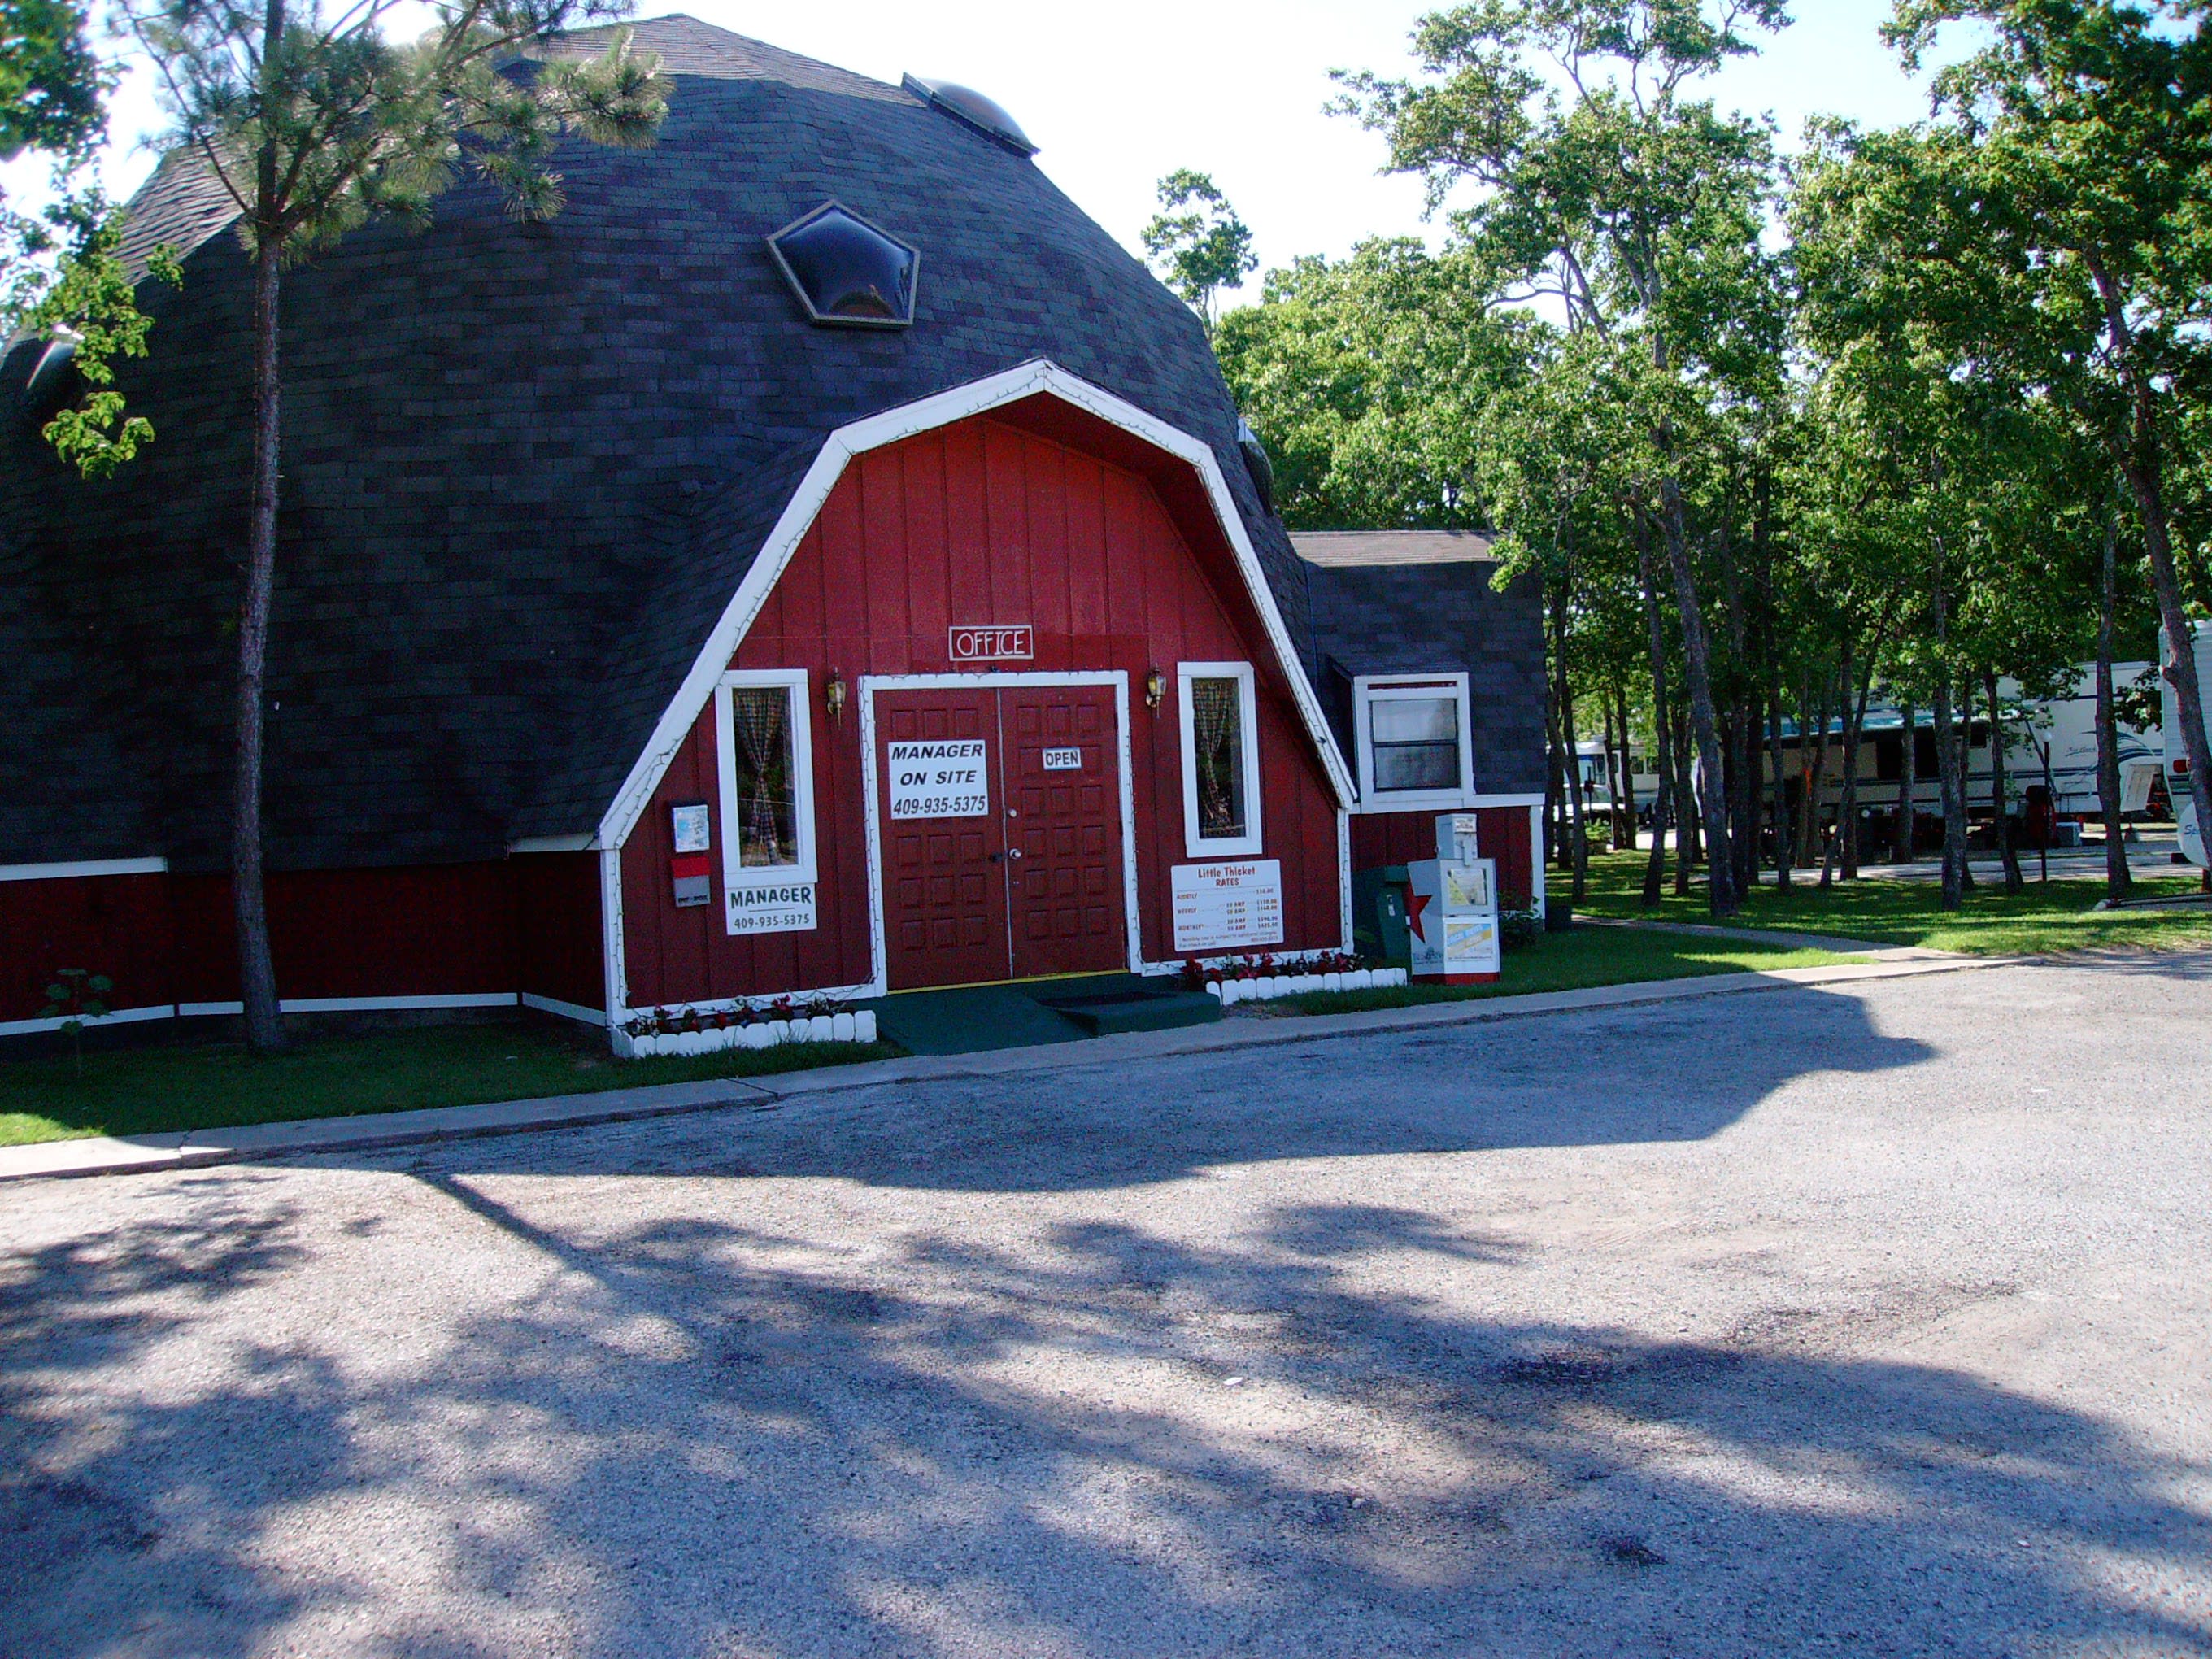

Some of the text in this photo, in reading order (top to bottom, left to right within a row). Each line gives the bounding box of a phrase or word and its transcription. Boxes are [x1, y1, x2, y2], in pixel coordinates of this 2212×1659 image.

[956, 630, 1026, 656] OFFICE
[891, 744, 983, 760] MANAGER
[1045, 751, 1079, 766] OPEN
[899, 770, 977, 786] ON SITE
[893, 795, 986, 814] 409-935-5375
[1198, 865, 1256, 878] Little Thicket
[1216, 877, 1239, 886] RATES
[729, 886, 812, 909] MANAGER
[734, 913, 810, 929] 409-935-5375
